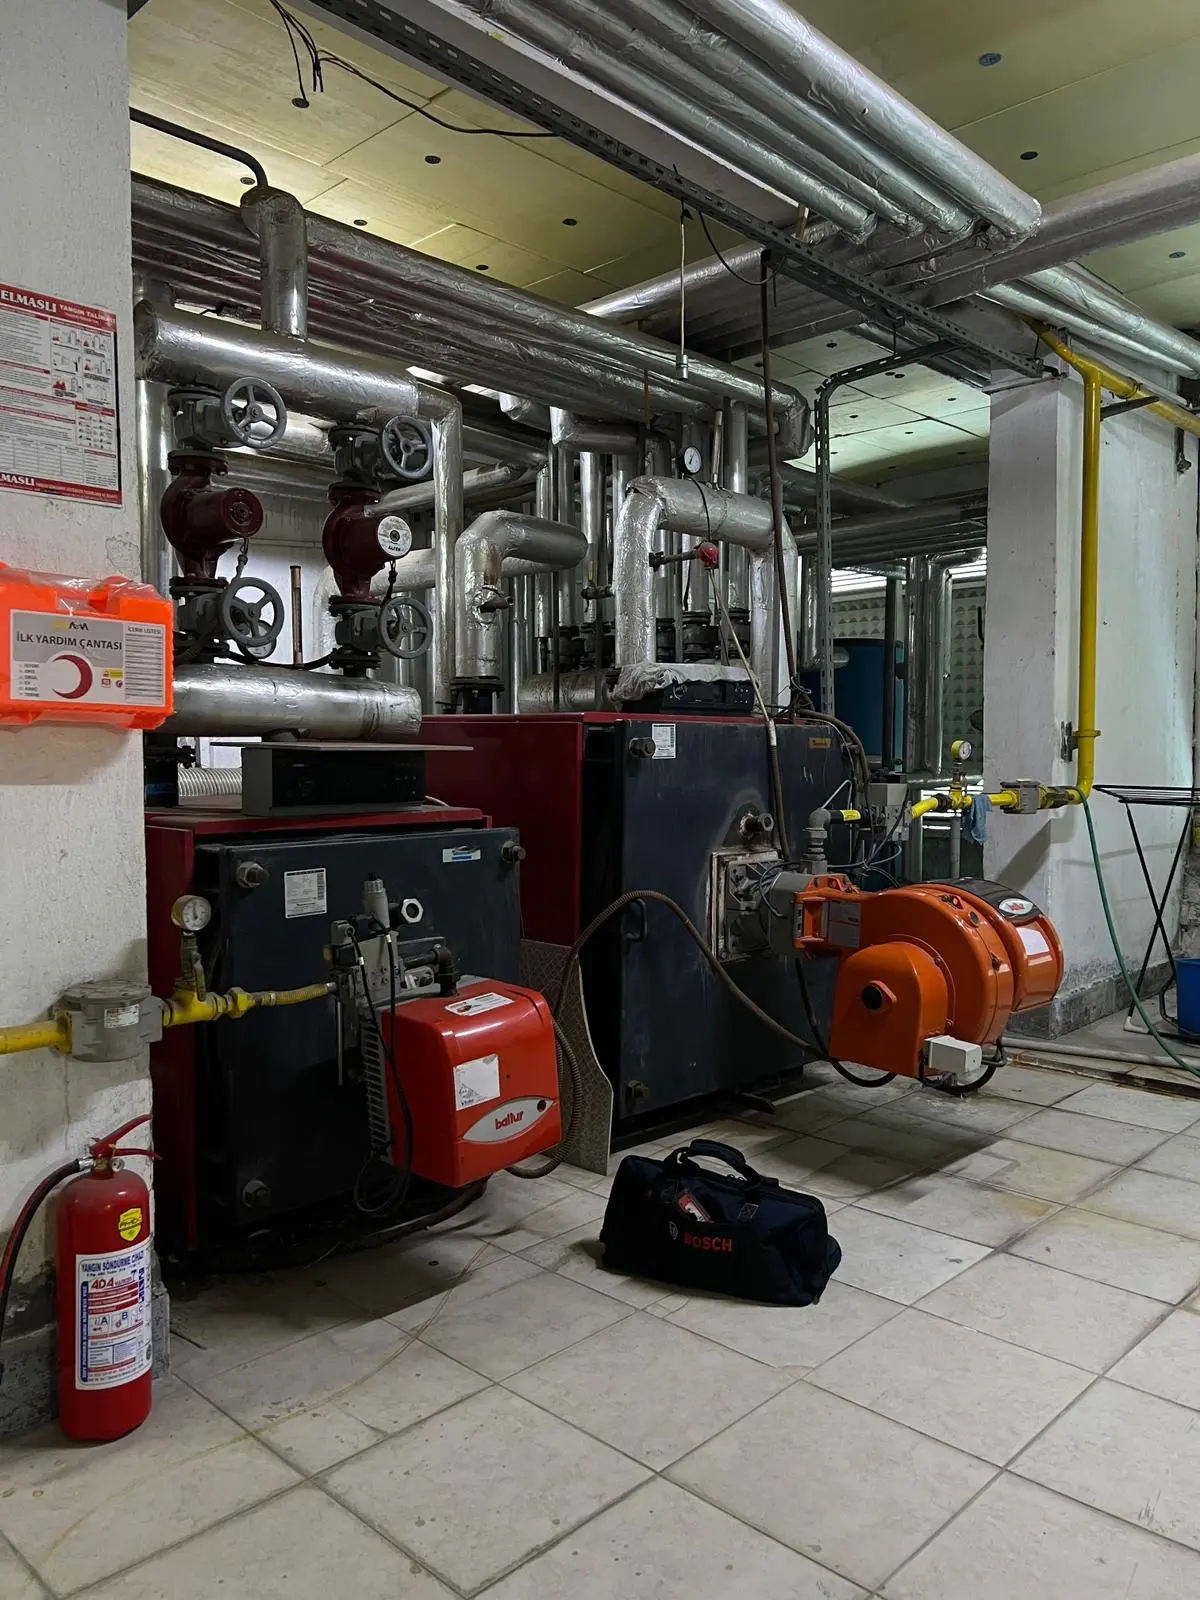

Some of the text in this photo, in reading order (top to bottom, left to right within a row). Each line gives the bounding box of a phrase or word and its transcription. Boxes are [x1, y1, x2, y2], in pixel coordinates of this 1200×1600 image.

[0, 289, 57, 313] ELMASLI
[16, 631, 122, 650] İLK YARDIM ÇANTASI
[494, 1110, 525, 1130] baltur
[683, 1231, 733, 1252] BOSCH
